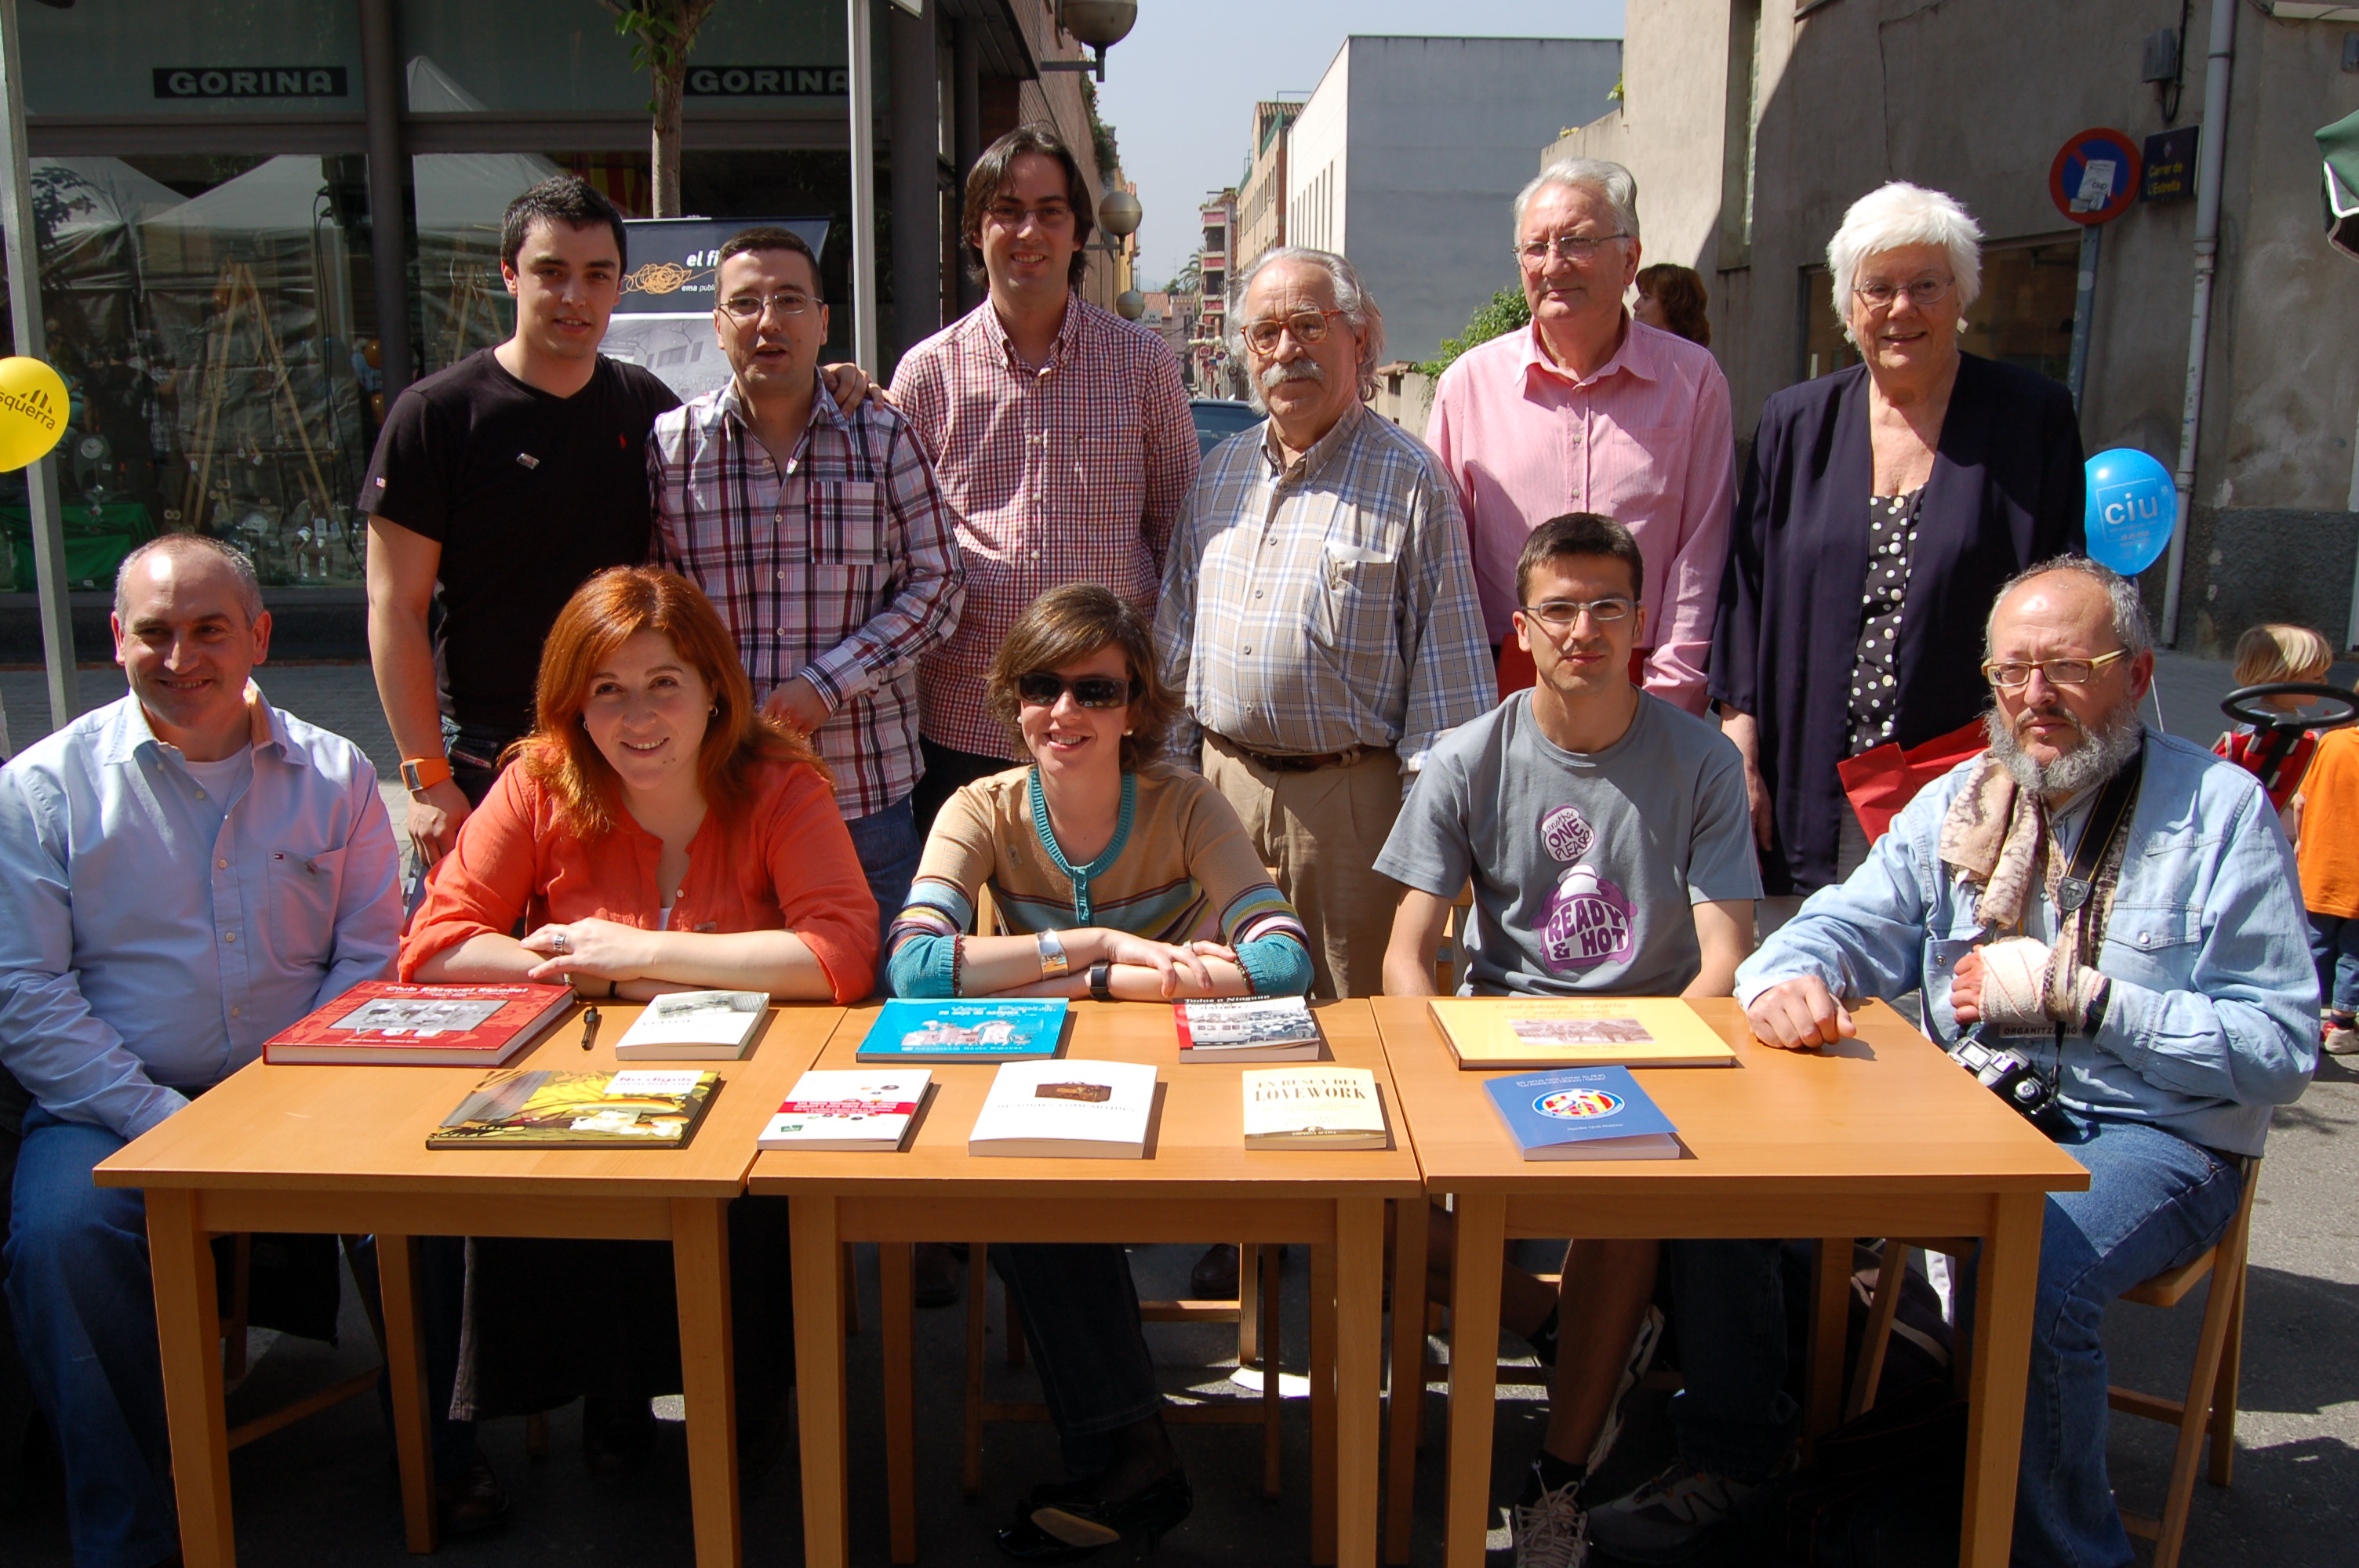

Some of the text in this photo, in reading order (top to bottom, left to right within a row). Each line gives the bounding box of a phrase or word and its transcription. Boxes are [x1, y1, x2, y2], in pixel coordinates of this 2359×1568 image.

[169, 71, 332, 94] GORINA
[691, 70, 849, 93] GORINA
[2149, 162, 2183, 176] Carrer de
[686, 250, 703, 267] el
[2105, 492, 2158, 524] ciu
[1548, 818, 1584, 848] ONE
[1548, 899, 1623, 942] READY
[1553, 927, 1626, 959] & HOT
[1256, 1087, 1367, 1102] LOVEWORK
